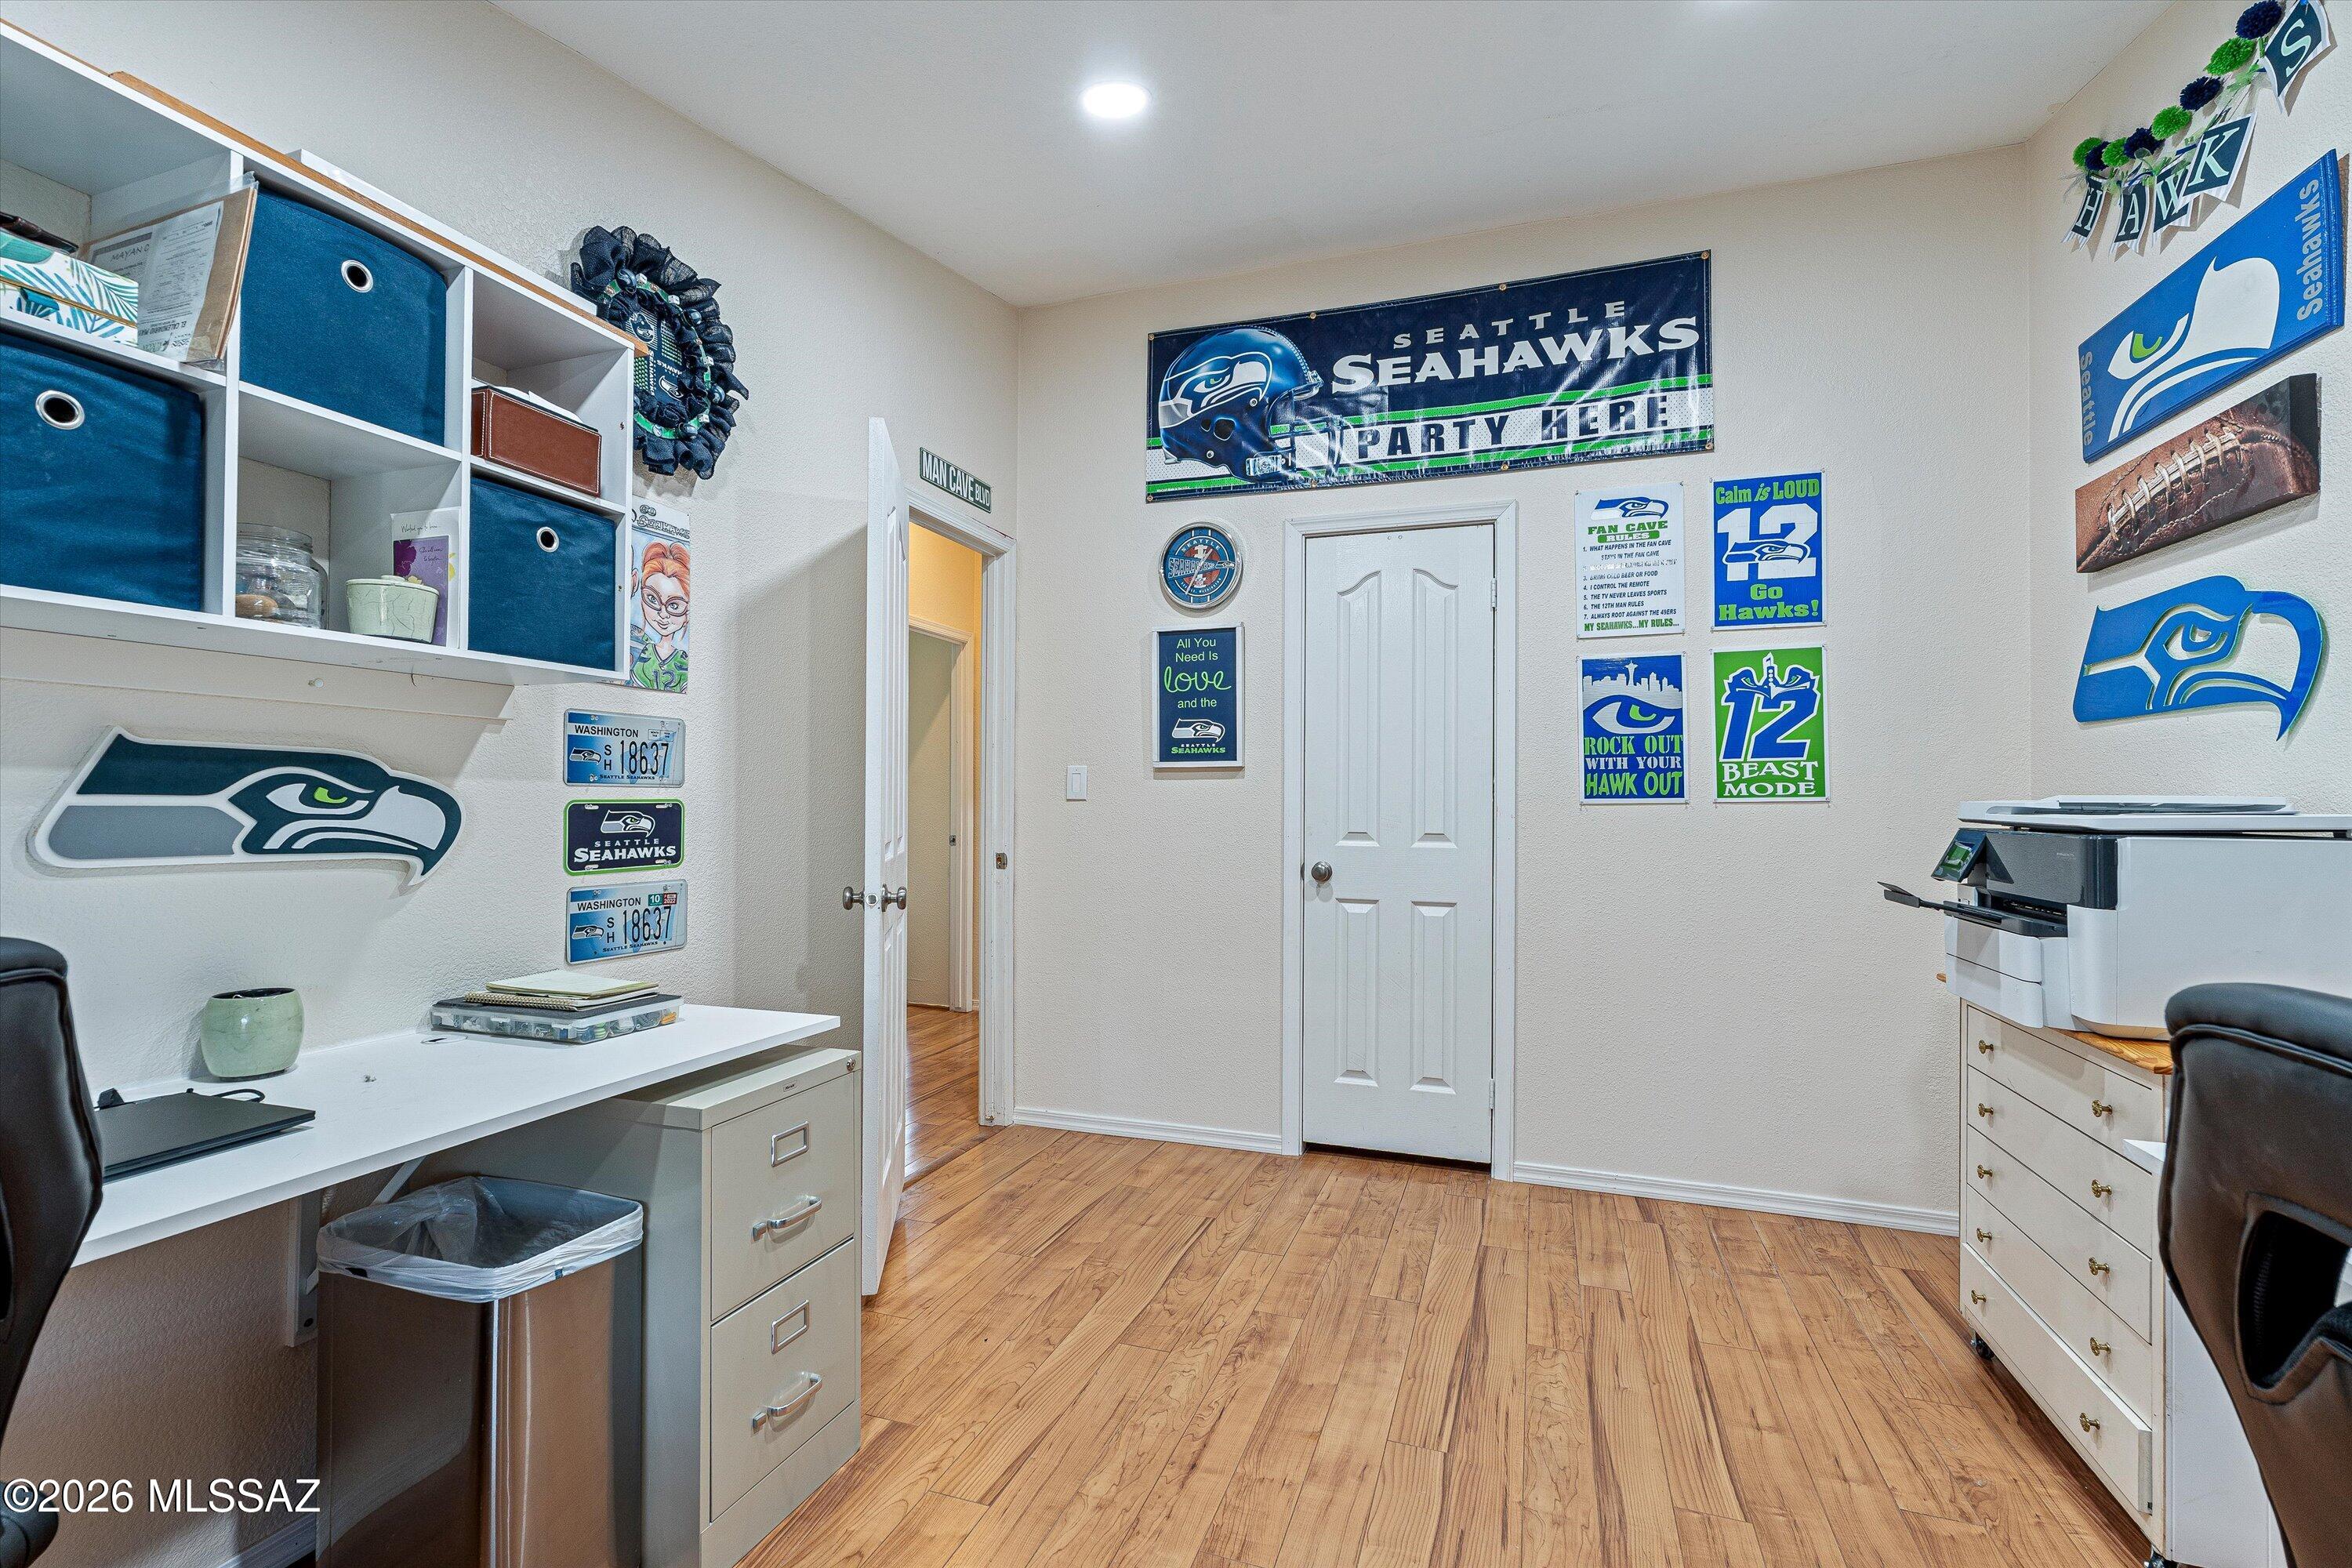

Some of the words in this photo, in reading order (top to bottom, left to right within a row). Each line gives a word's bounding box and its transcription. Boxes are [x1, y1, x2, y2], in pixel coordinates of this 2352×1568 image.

[2296, 178, 2323, 321] Seahawks
[1392, 300, 1625, 349] SEATTLE
[1331, 317, 1700, 394] SEAHAWKS
[2080, 350, 2094, 446] Seattle
[1357, 415, 1511, 459] PARTY
[1541, 395, 1668, 441] HERE
[922, 450, 947, 488] MAN
[949, 466, 975, 502] CAVE
[975, 483, 991, 507] BLVD
[1715, 485, 1751, 505] Calm
[1754, 483, 1771, 502] is
[1773, 478, 1820, 500] LOUD
[1588, 524, 1618, 535] FAN
[1626, 521, 1668, 533] CAVE
[1606, 532, 1650, 543] RULES
[1181, 539, 1221, 553] SEATTLE
[1717, 503, 1818, 582] 12
[1750, 584, 1783, 600] Go
[1719, 600, 1819, 620] Hawks!
[1651, 618, 1679, 627] RULES...
[1177, 638, 1191, 648] All
[1194, 637, 1216, 648] You
[1175, 652, 1205, 662] Need
[1209, 651, 1218, 660] Is
[1163, 666, 1232, 693] love
[1178, 698, 1197, 708] and
[1201, 697, 1217, 707] the
[1719, 666, 1821, 761] 12
[575, 724, 639, 738] WASHINGTON
[1584, 735, 1636, 755] ROCK
[1645, 735, 1683, 754] OUT
[620, 740, 669, 775] 18637
[1585, 757, 1628, 770] WITH
[1638, 757, 1682, 769] YOUR
[1722, 761, 1819, 782] BEAST
[1585, 772, 1638, 796] HAWK
[1644, 771, 1683, 796] OUT
[1723, 782, 1817, 797] MODE
[595, 838, 660, 848] SEATTLE
[574, 845, 677, 863] SEAHAWKS
[577, 898, 641, 912] WASHINGTON
[650, 894, 660, 903] 10
[622, 906, 672, 944] 18637
